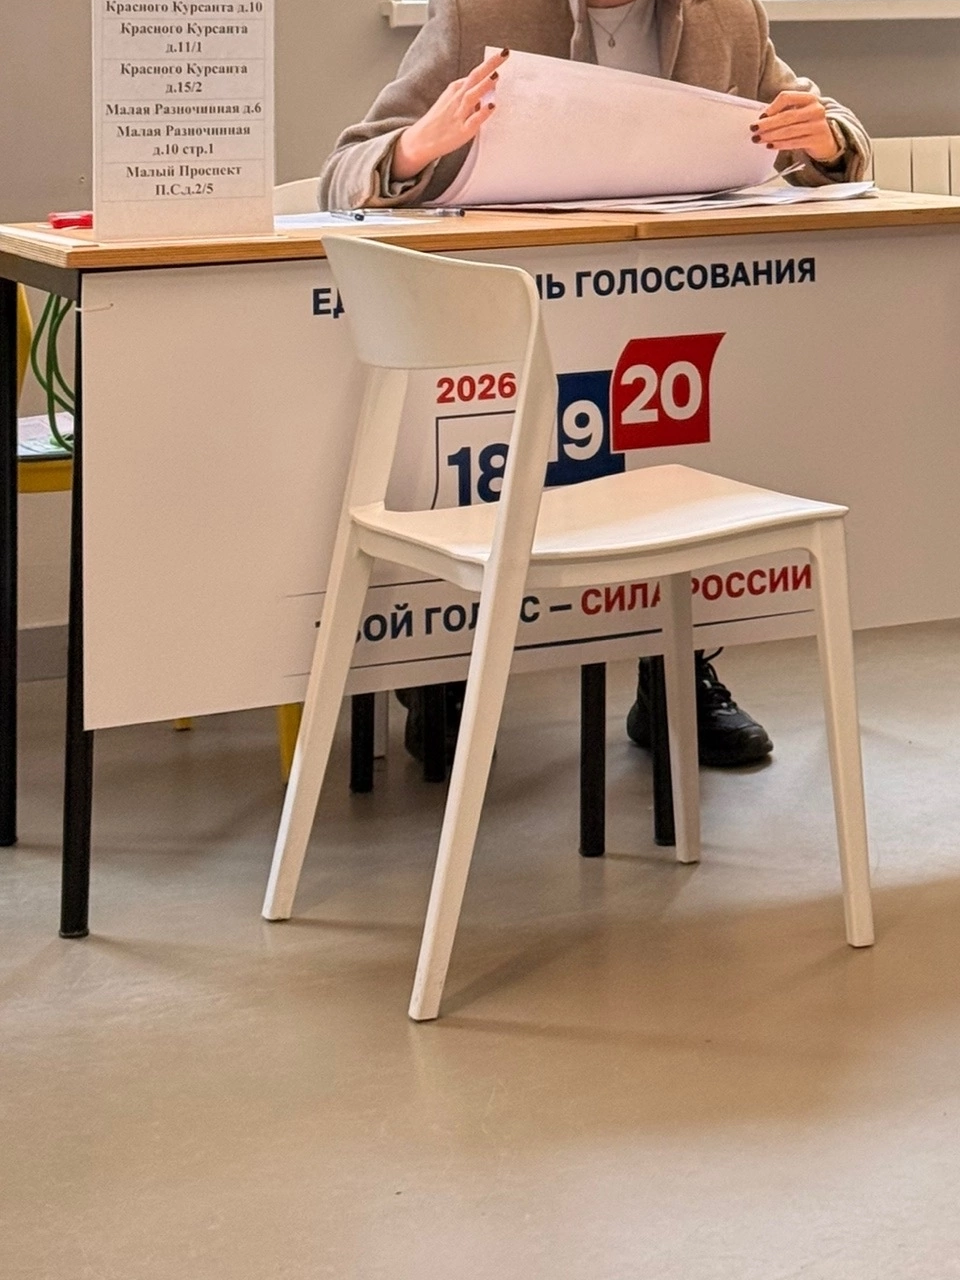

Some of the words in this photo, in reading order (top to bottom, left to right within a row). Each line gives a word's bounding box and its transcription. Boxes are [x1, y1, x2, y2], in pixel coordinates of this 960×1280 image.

[106, 1, 169, 15] Красного
[172, 1, 234, 15] Курсанта
[237, 1, 263, 13] д.10
[120, 22, 183, 36] Красного
[187, 22, 248, 37] Курсанта
[165, 41, 202, 54] д.11/1
[120, 62, 183, 77] Красного
[186, 62, 248, 77] Курсанта
[165, 81, 203, 94] д.15/2
[105, 104, 150, 115] Малая
[154, 103, 240, 115] Разночинная
[242, 102, 262, 114] д.6
[116, 126, 161, 137] Малая
[165, 124, 251, 137] Разночинная
[152, 143, 179, 156] д.10
[182, 143, 214, 157] стр.1
[126, 165, 175, 178] Малый
[179, 165, 242, 179] Проспект
[575, 257, 816, 298] ГОЛОСОВАНИЯ
[436, 372, 517, 404] 2026
[620, 360, 703, 425] 20
[447, 443, 510, 507] 18
